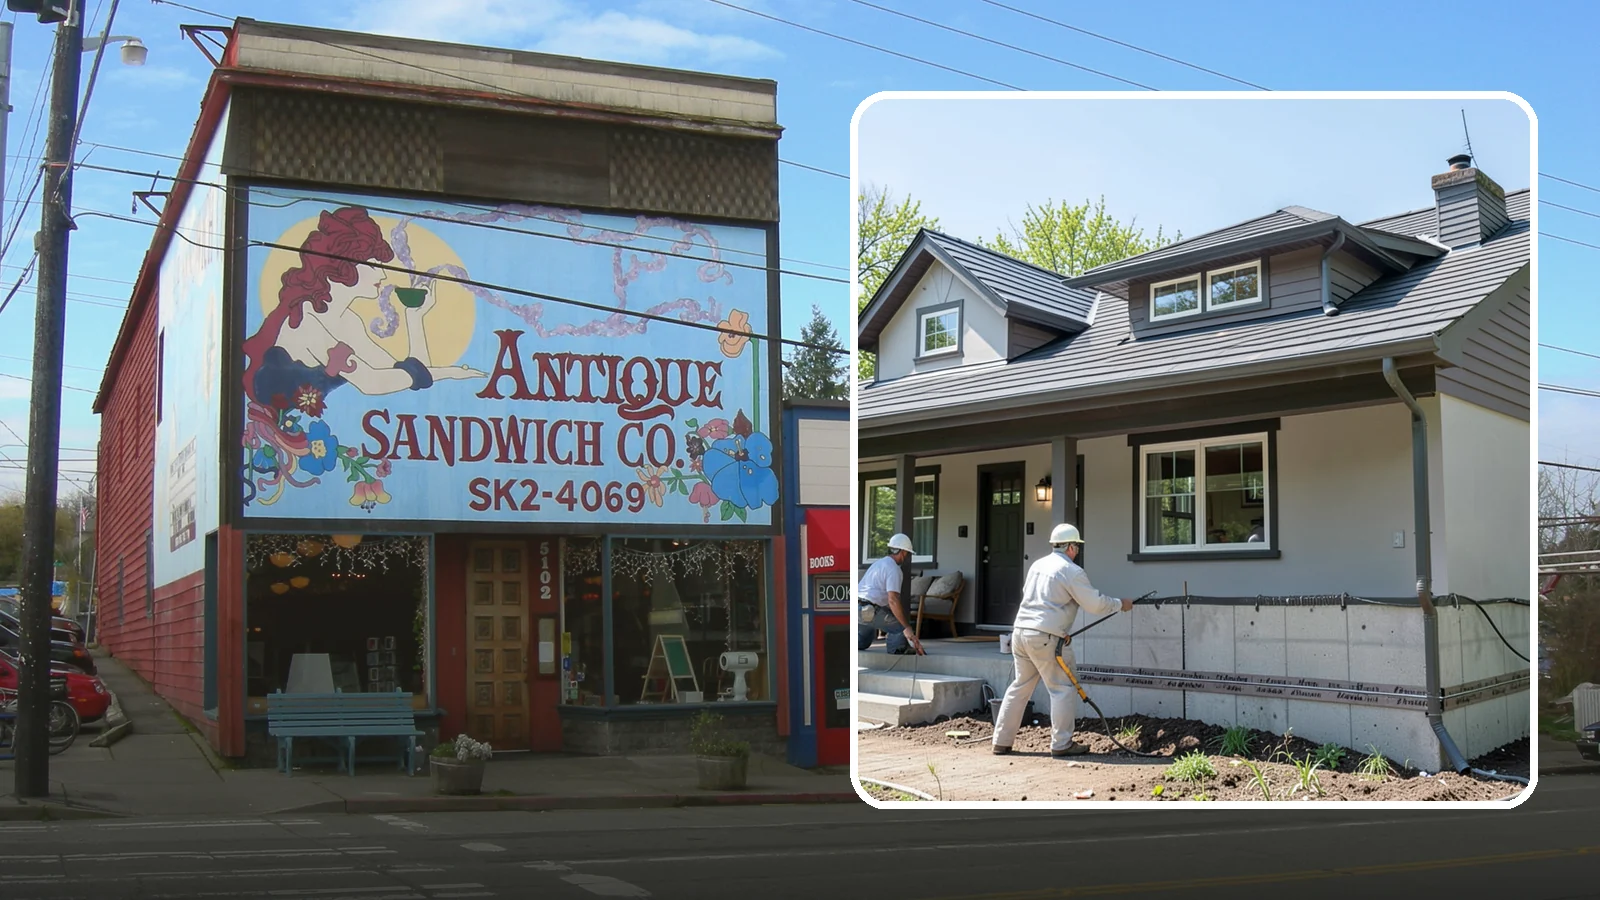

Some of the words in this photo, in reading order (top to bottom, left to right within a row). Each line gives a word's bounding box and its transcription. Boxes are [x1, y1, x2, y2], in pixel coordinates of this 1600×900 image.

[475, 329, 724, 421] ANTIQUE
[361, 408, 604, 467] SANDWICH
[617, 422, 685, 469] CO.
[468, 477, 646, 513] SK2-4069
[539, 542, 552, 600] 5102
[809, 555, 835, 569] BOOKS
